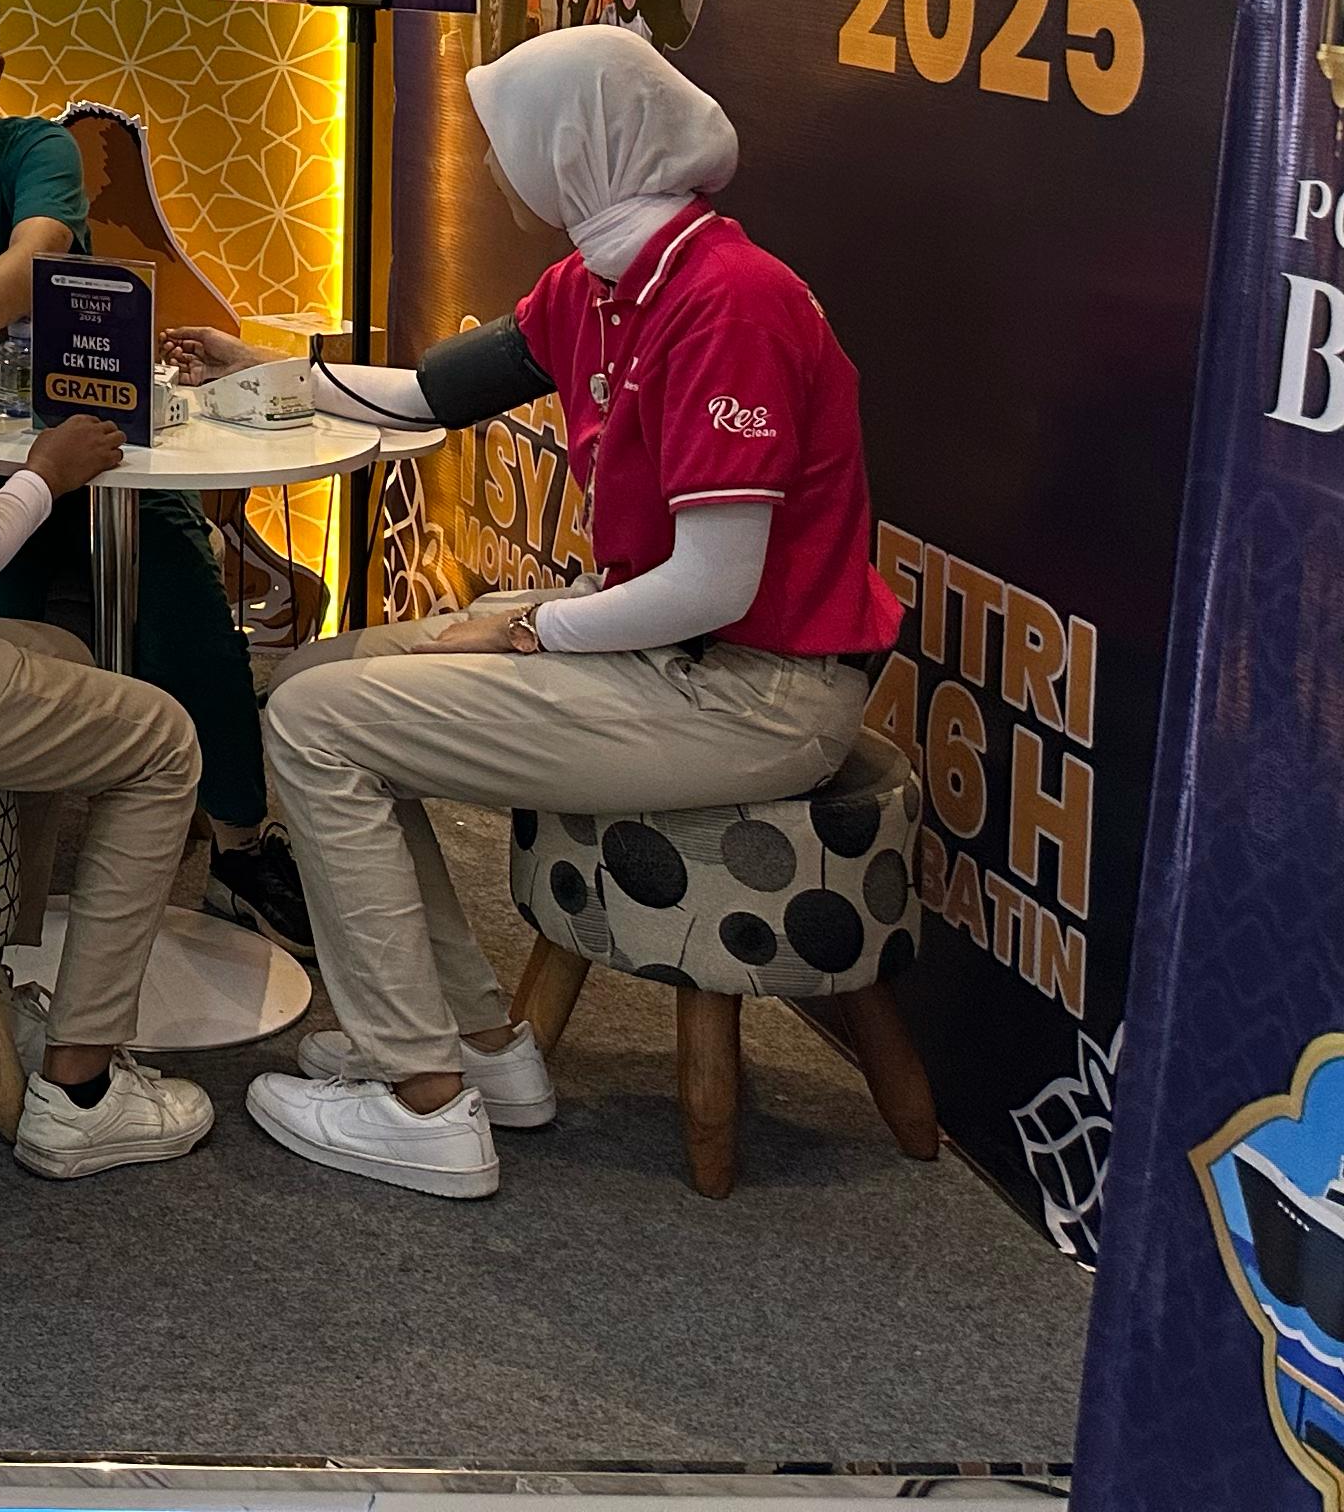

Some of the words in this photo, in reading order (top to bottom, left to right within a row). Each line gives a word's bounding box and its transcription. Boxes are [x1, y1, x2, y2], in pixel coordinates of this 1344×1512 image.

[70, 297, 112, 312] BUMN
[72, 334, 111, 352] NAKES
[62, 352, 85, 369] CEK
[86, 355, 120, 373] TENSI
[51, 378, 132, 405] GRATIS
[708, 395, 772, 433] Res
[742, 427, 777, 438] Clean
[485, 420, 598, 576] SYA
[862, 650, 988, 840] 46
[1008, 723, 1095, 920] H
